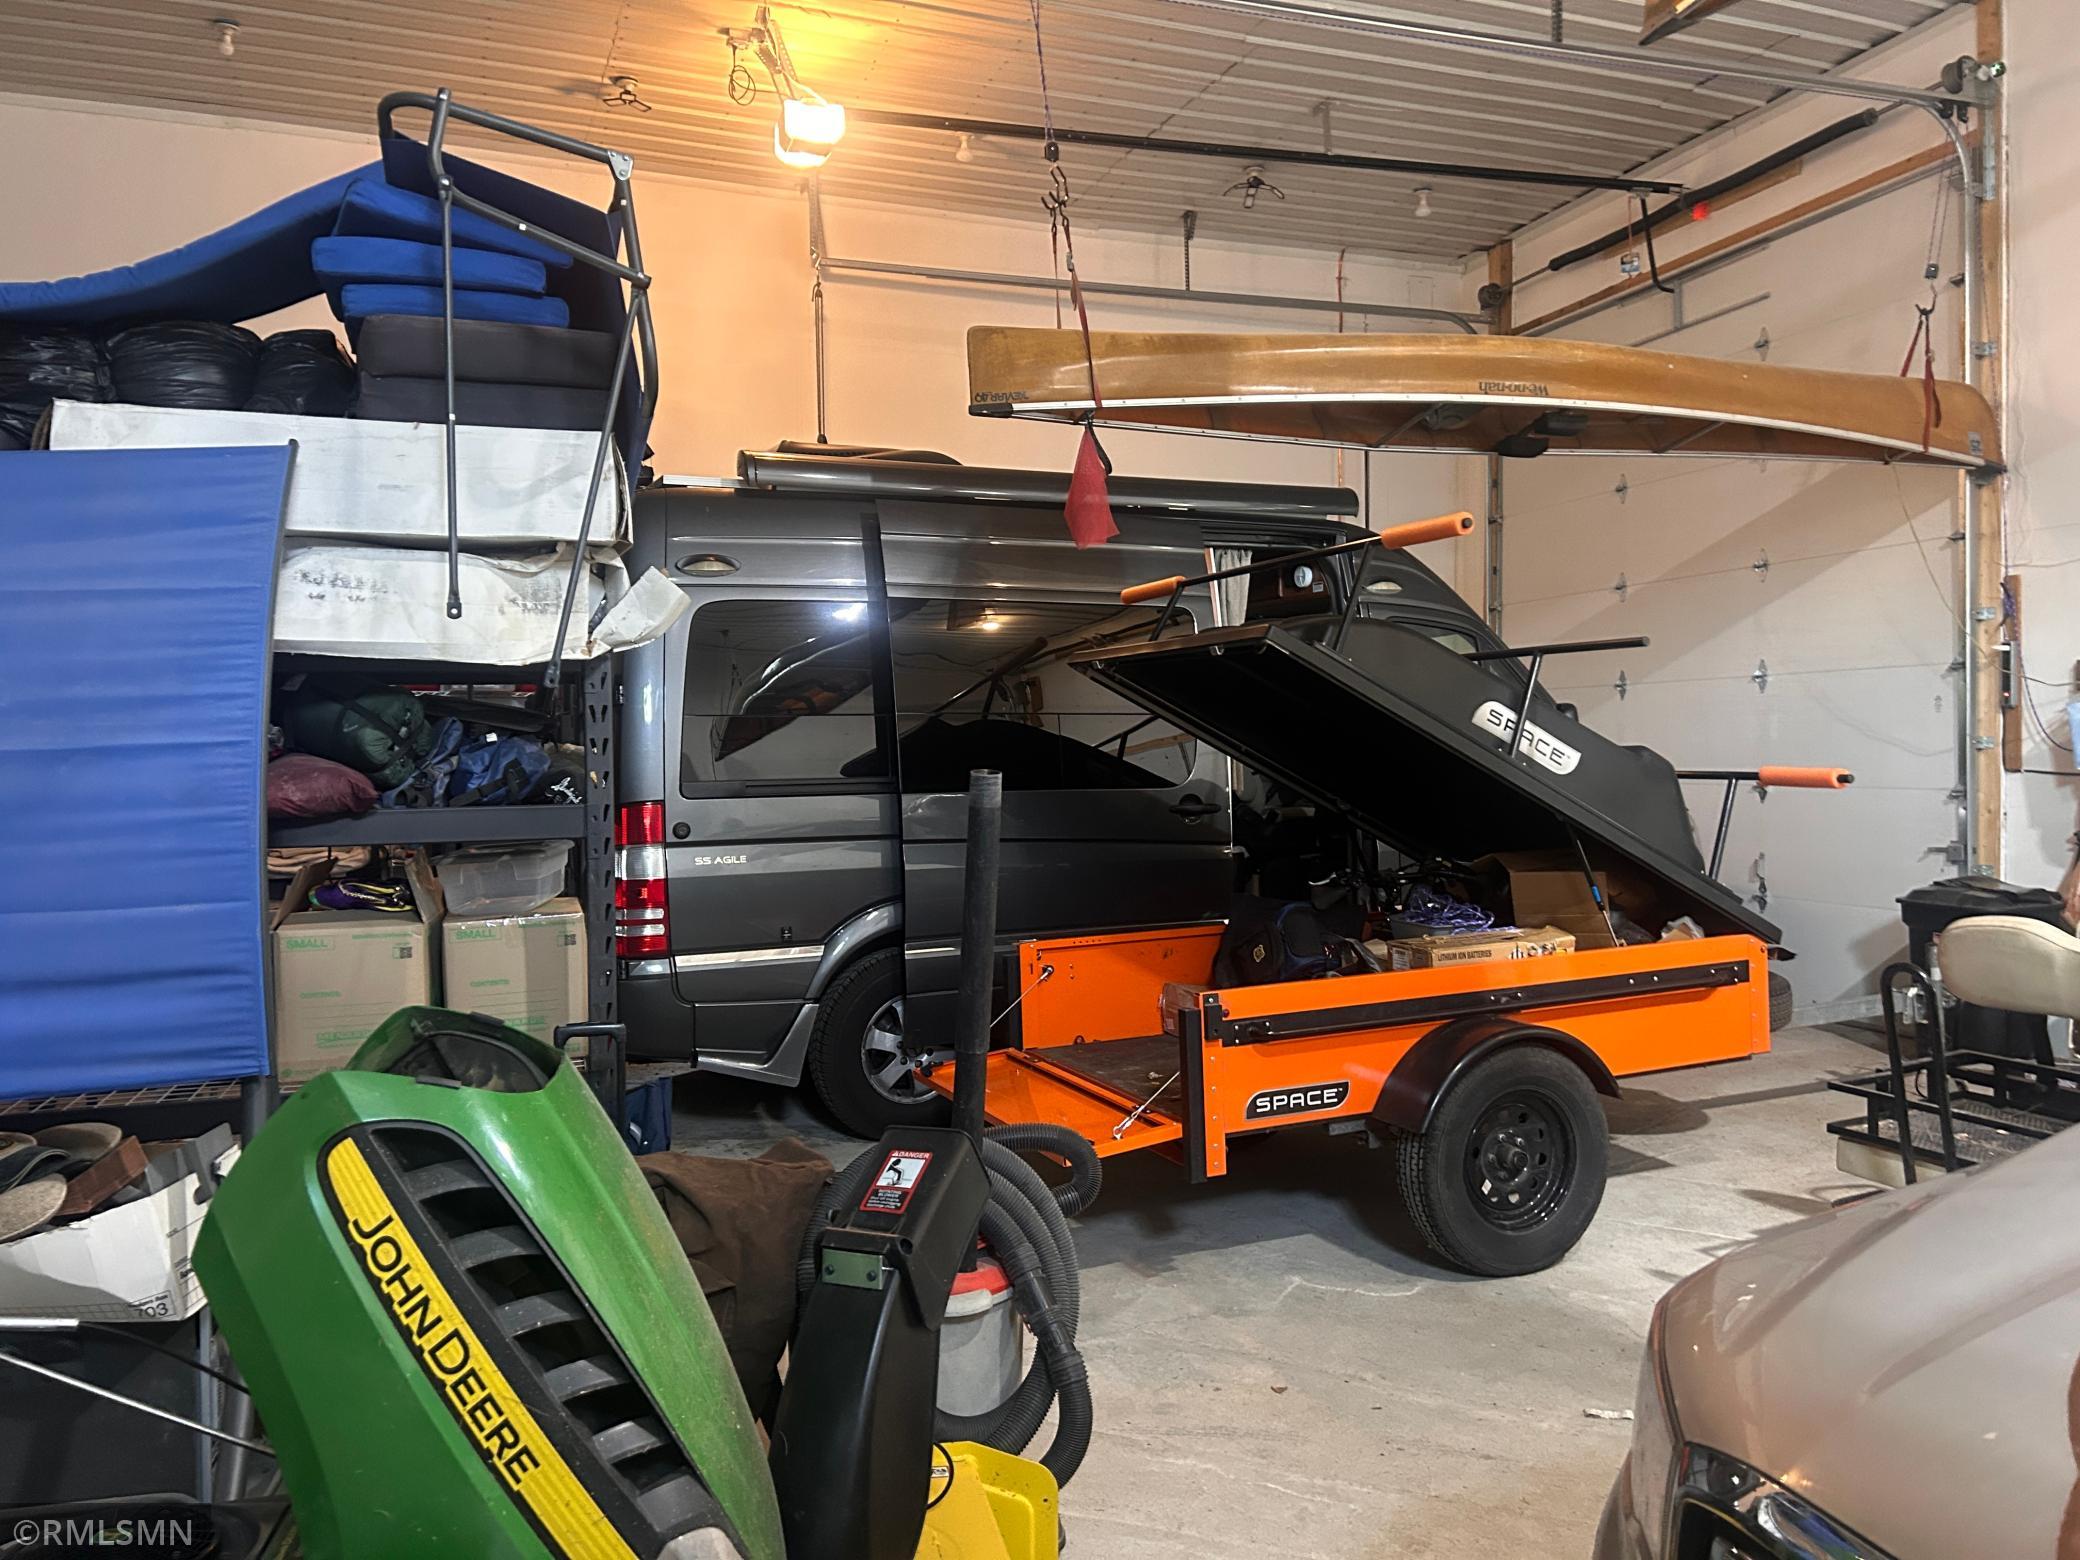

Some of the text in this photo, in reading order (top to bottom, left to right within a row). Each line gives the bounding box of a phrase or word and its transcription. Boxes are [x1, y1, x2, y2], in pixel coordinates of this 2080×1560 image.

[694, 855, 747, 866] SS AGILE
[456, 929, 497, 940] SMALL
[286, 939, 329, 950] SMALL
[1438, 949, 1492, 961] LITHIUM ION BATTERIES
[1255, 1087, 1339, 1113] SPACE
[899, 1151, 930, 1159] DANGER
[351, 1214, 541, 1485] JOHN DEERE
